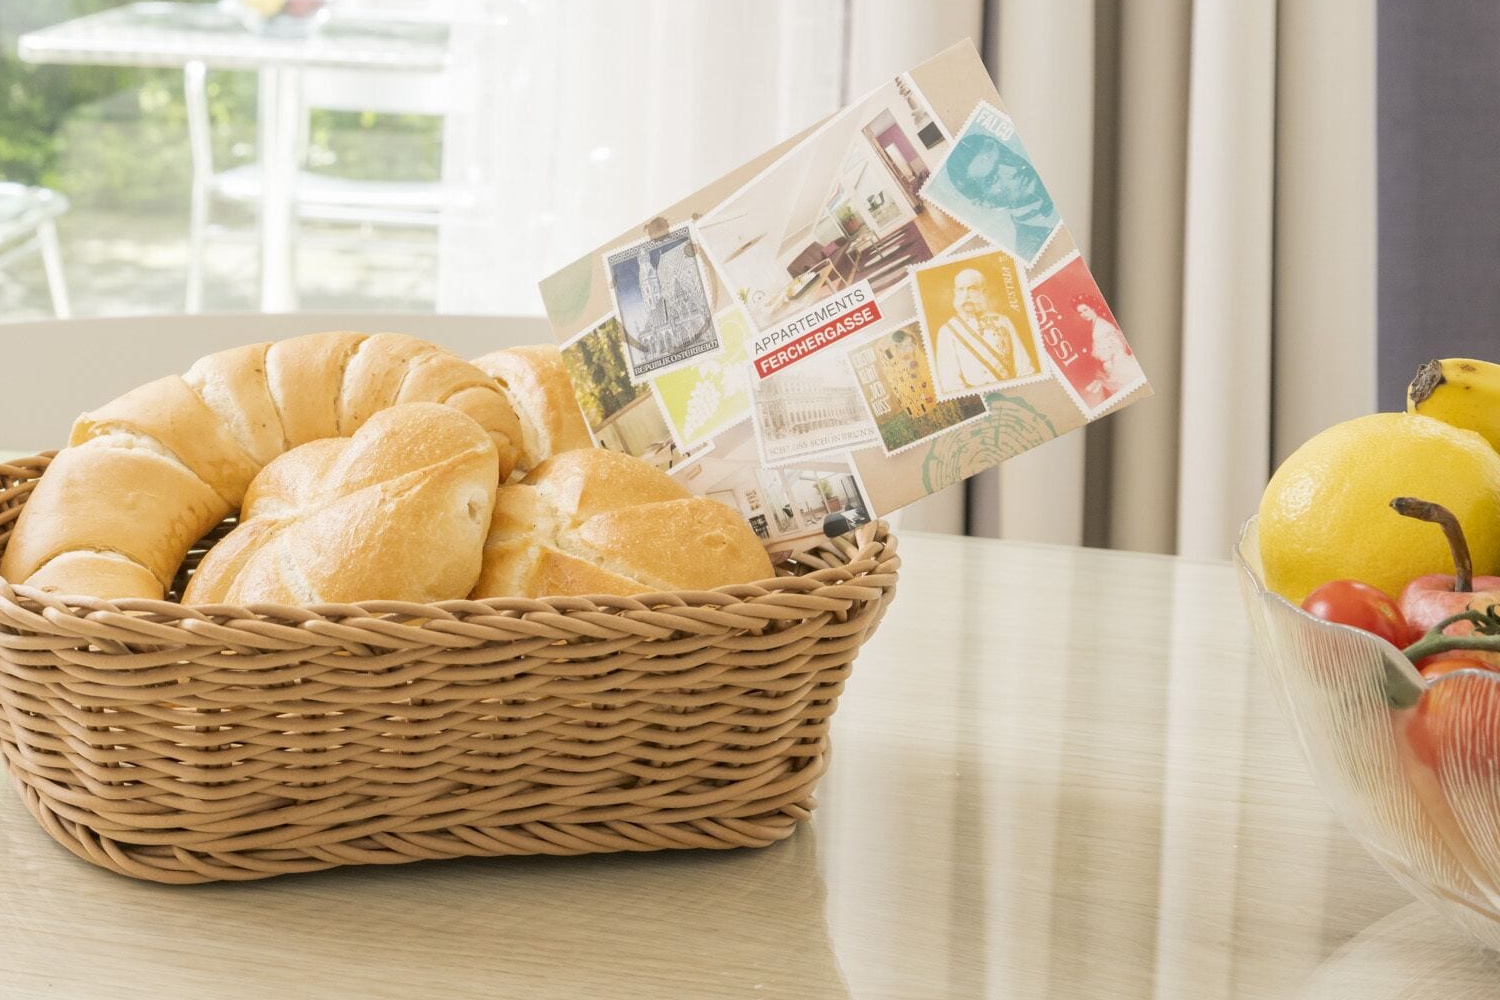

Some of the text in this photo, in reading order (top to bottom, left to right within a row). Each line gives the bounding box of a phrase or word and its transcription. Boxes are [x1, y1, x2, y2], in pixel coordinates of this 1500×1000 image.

[975, 108, 1016, 141] FALCO
[1002, 266, 1020, 312] AUSTRIA
[754, 289, 865, 355] APPARTEMENTS
[760, 307, 875, 374] FERCHERGASSE
